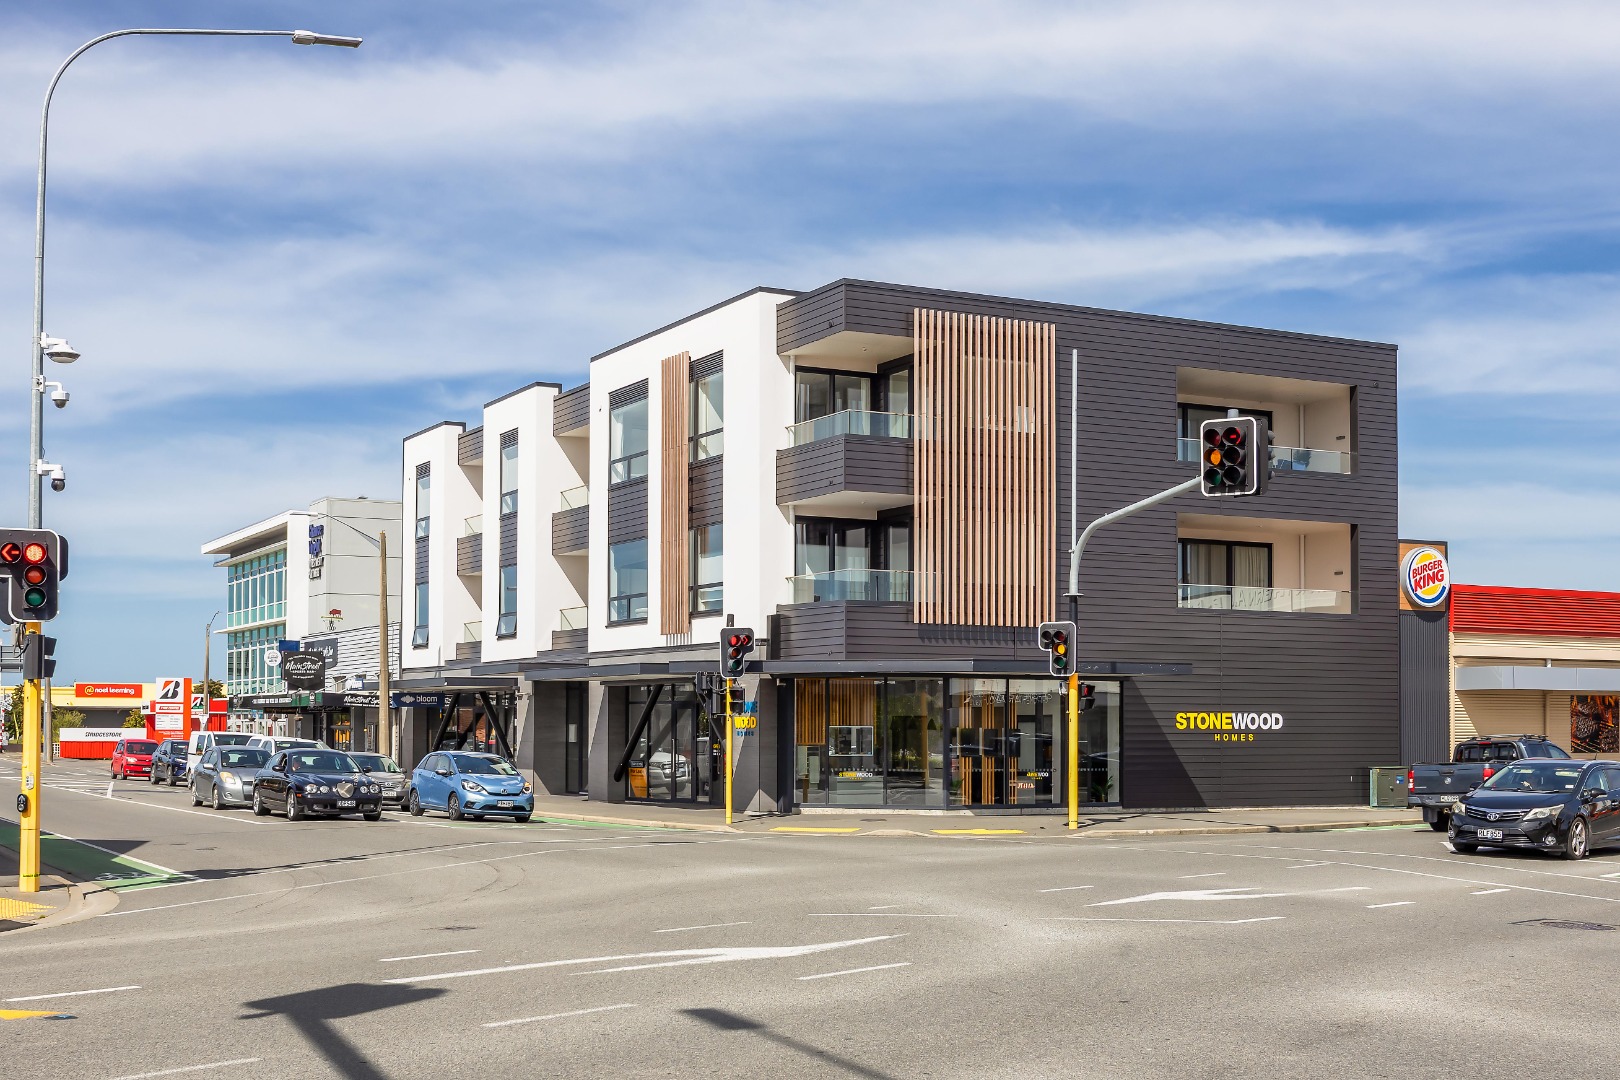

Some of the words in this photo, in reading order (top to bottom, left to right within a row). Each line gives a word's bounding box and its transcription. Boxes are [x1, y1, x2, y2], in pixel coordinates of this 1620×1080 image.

[1412, 560, 1443, 579] BURGER
[1413, 569, 1445, 593] KING
[109, 687, 135, 695] leeming
[416, 695, 438, 703] bloom
[734, 716, 757, 729] WOOD
[1175, 712, 1284, 730] STONEWOOD
[1214, 733, 1254, 742] HOMES
